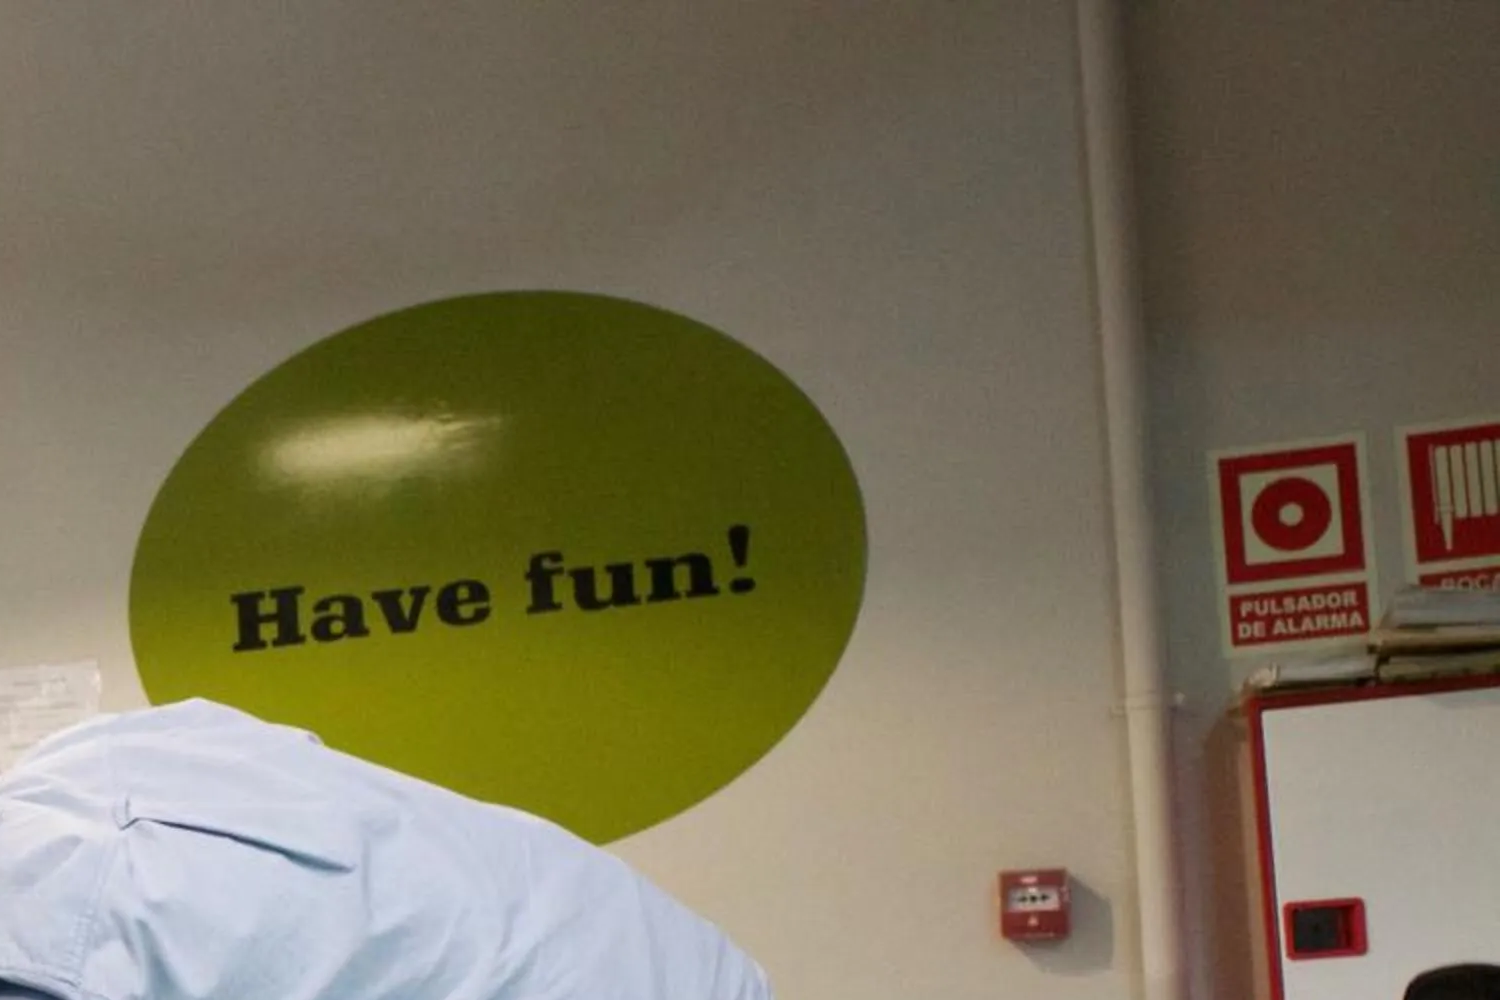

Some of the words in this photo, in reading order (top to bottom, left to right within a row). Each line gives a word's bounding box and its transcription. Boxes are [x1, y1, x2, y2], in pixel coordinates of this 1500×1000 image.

[230, 577, 491, 652] Have
[524, 525, 756, 615] fun!
[1241, 590, 1357, 617] PULSADOR
[1238, 621, 1266, 638] DE
[1272, 610, 1363, 635] ALARMA
